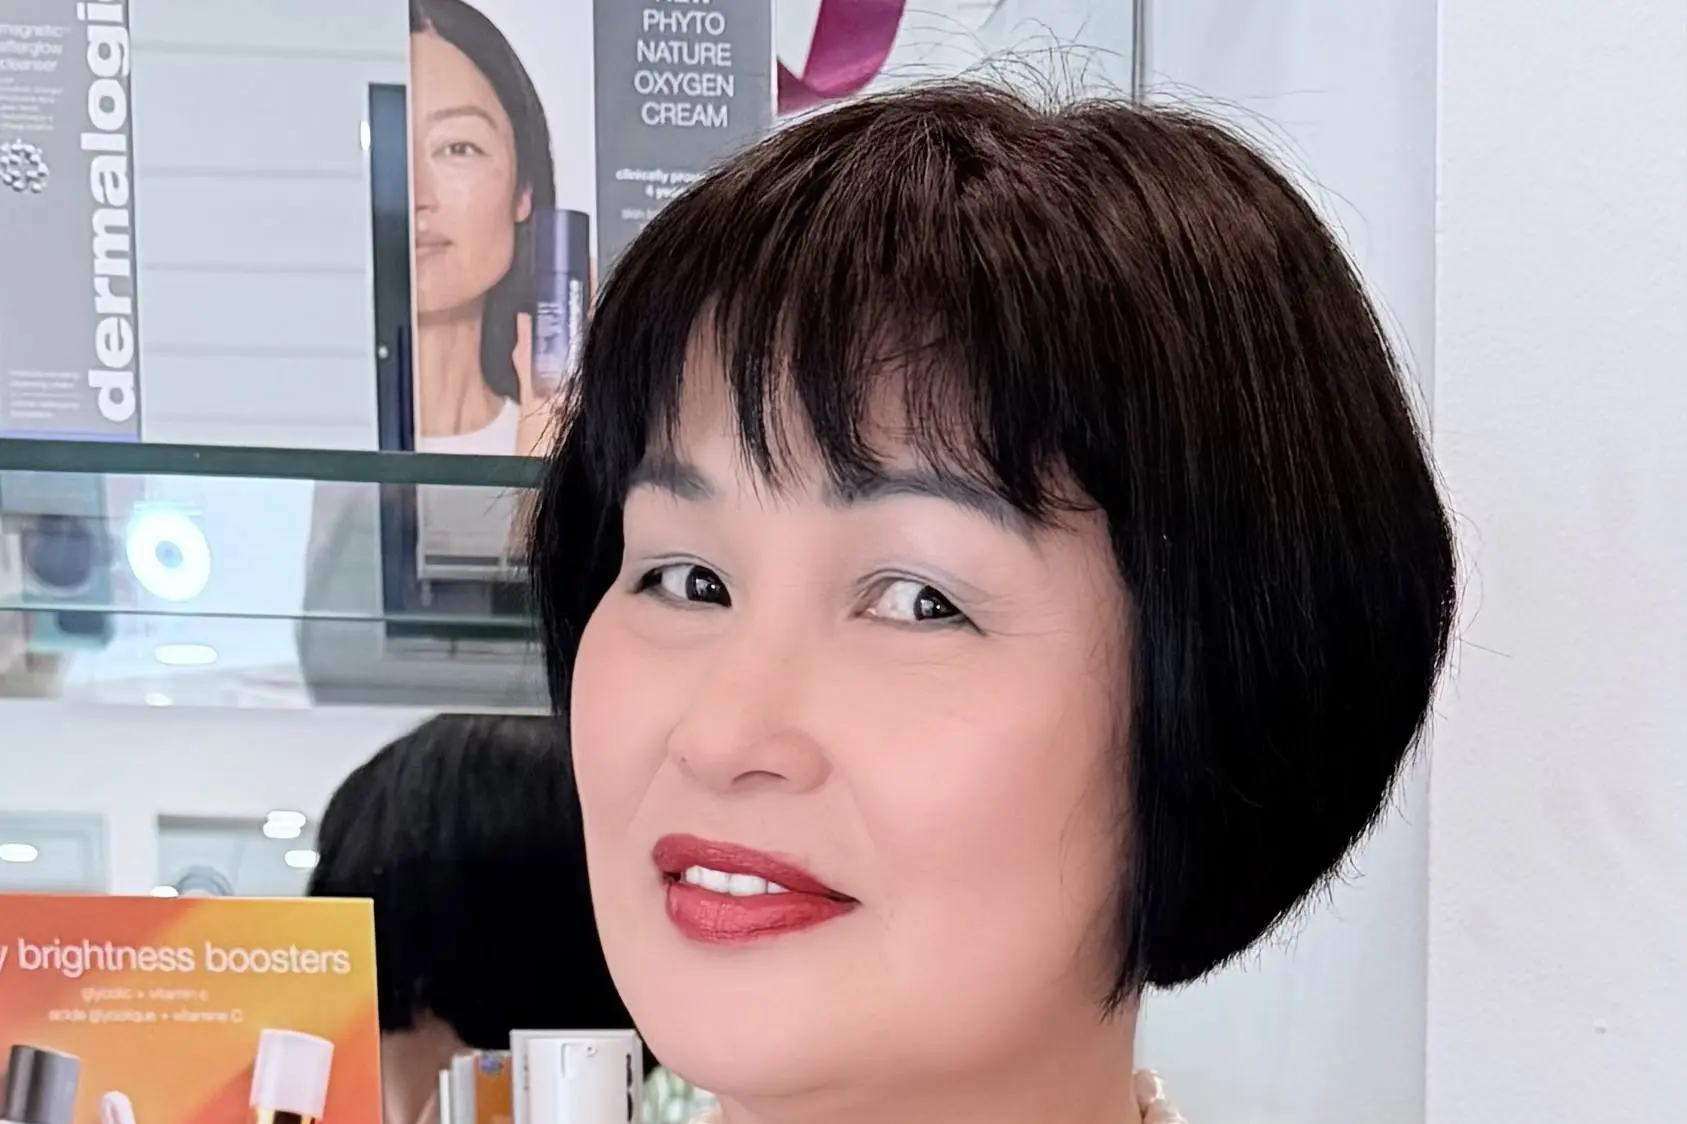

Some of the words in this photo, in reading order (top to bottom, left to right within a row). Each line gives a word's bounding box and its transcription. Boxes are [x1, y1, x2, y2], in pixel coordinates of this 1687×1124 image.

[643, 8, 726, 35] PHYTO
[637, 39, 732, 66] NATURE
[634, 70, 734, 97] OXYGEN
[641, 101, 728, 127] CREAM
[77, 0, 135, 421] dermalogi
[18, 937, 196, 978] brightness
[205, 940, 351, 974] boosters
